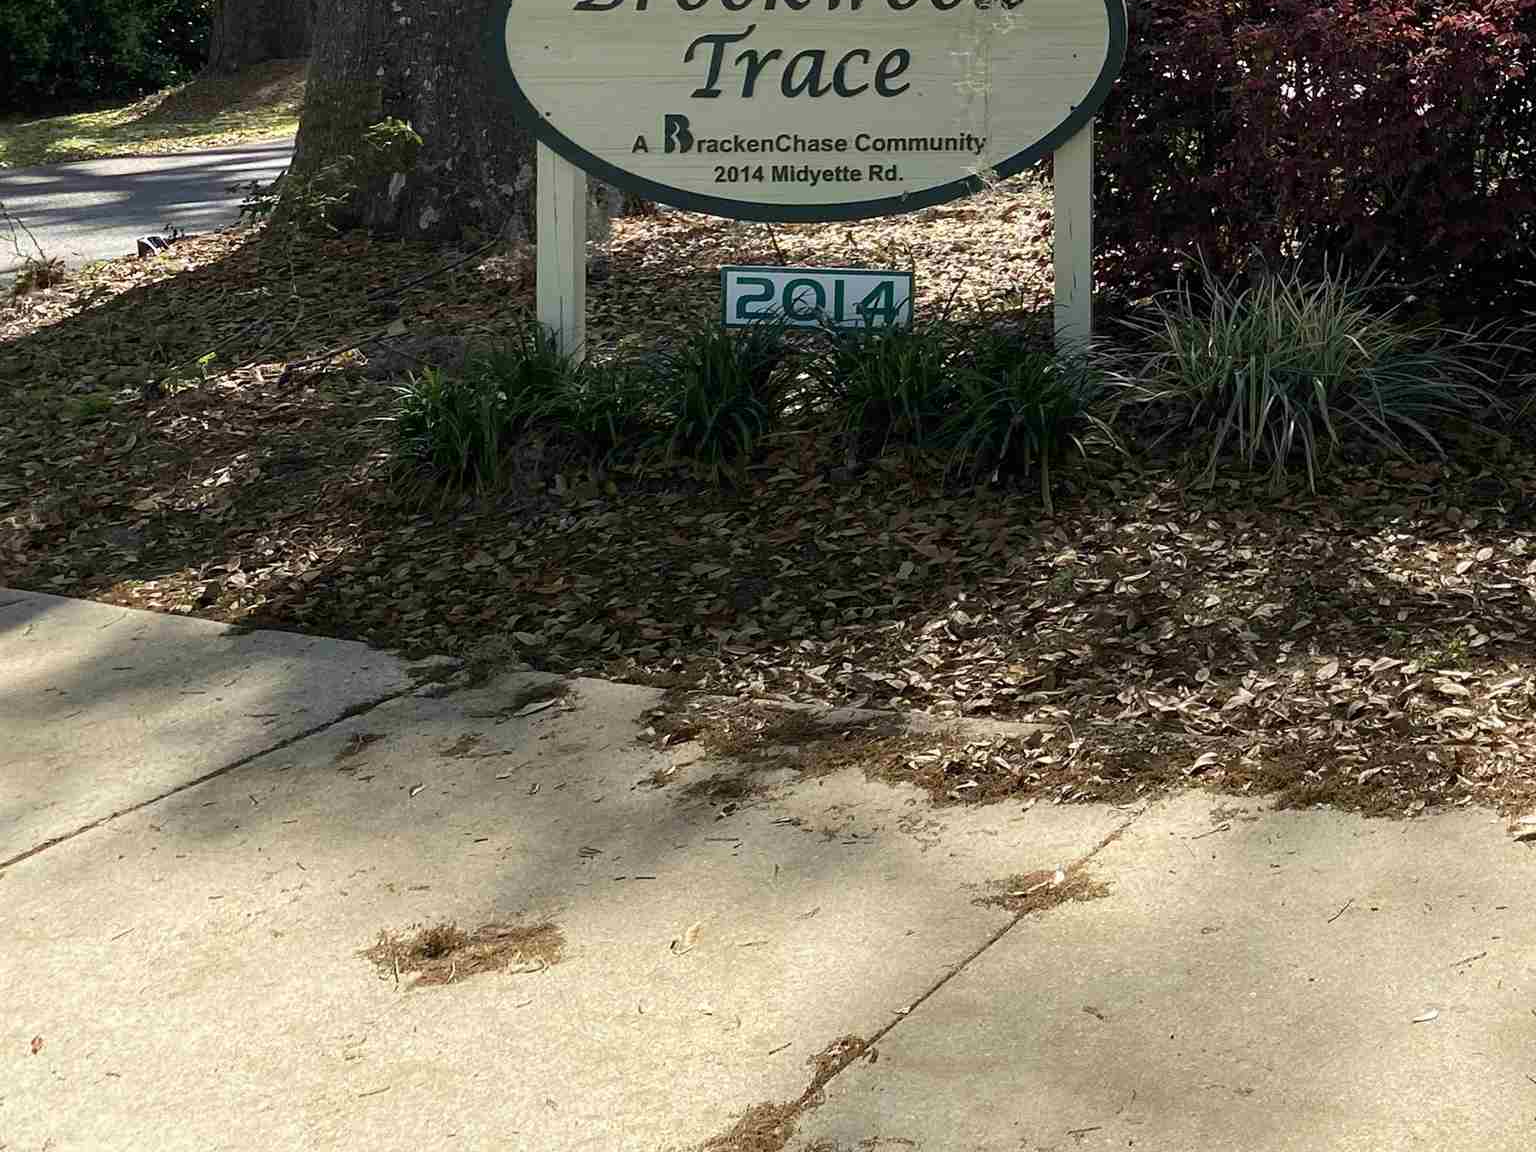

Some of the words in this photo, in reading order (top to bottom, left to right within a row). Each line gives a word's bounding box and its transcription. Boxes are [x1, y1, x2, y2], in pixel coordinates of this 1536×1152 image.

[683, 23, 912, 99] Trace
[631, 135, 650, 154] A
[663, 113, 850, 155] BrackenChase
[854, 132, 988, 156] Community
[713, 165, 766, 183] 2014
[771, 163, 863, 187] Midyette
[868, 164, 904, 183] Rd.
[736, 276, 896, 323] 2014
